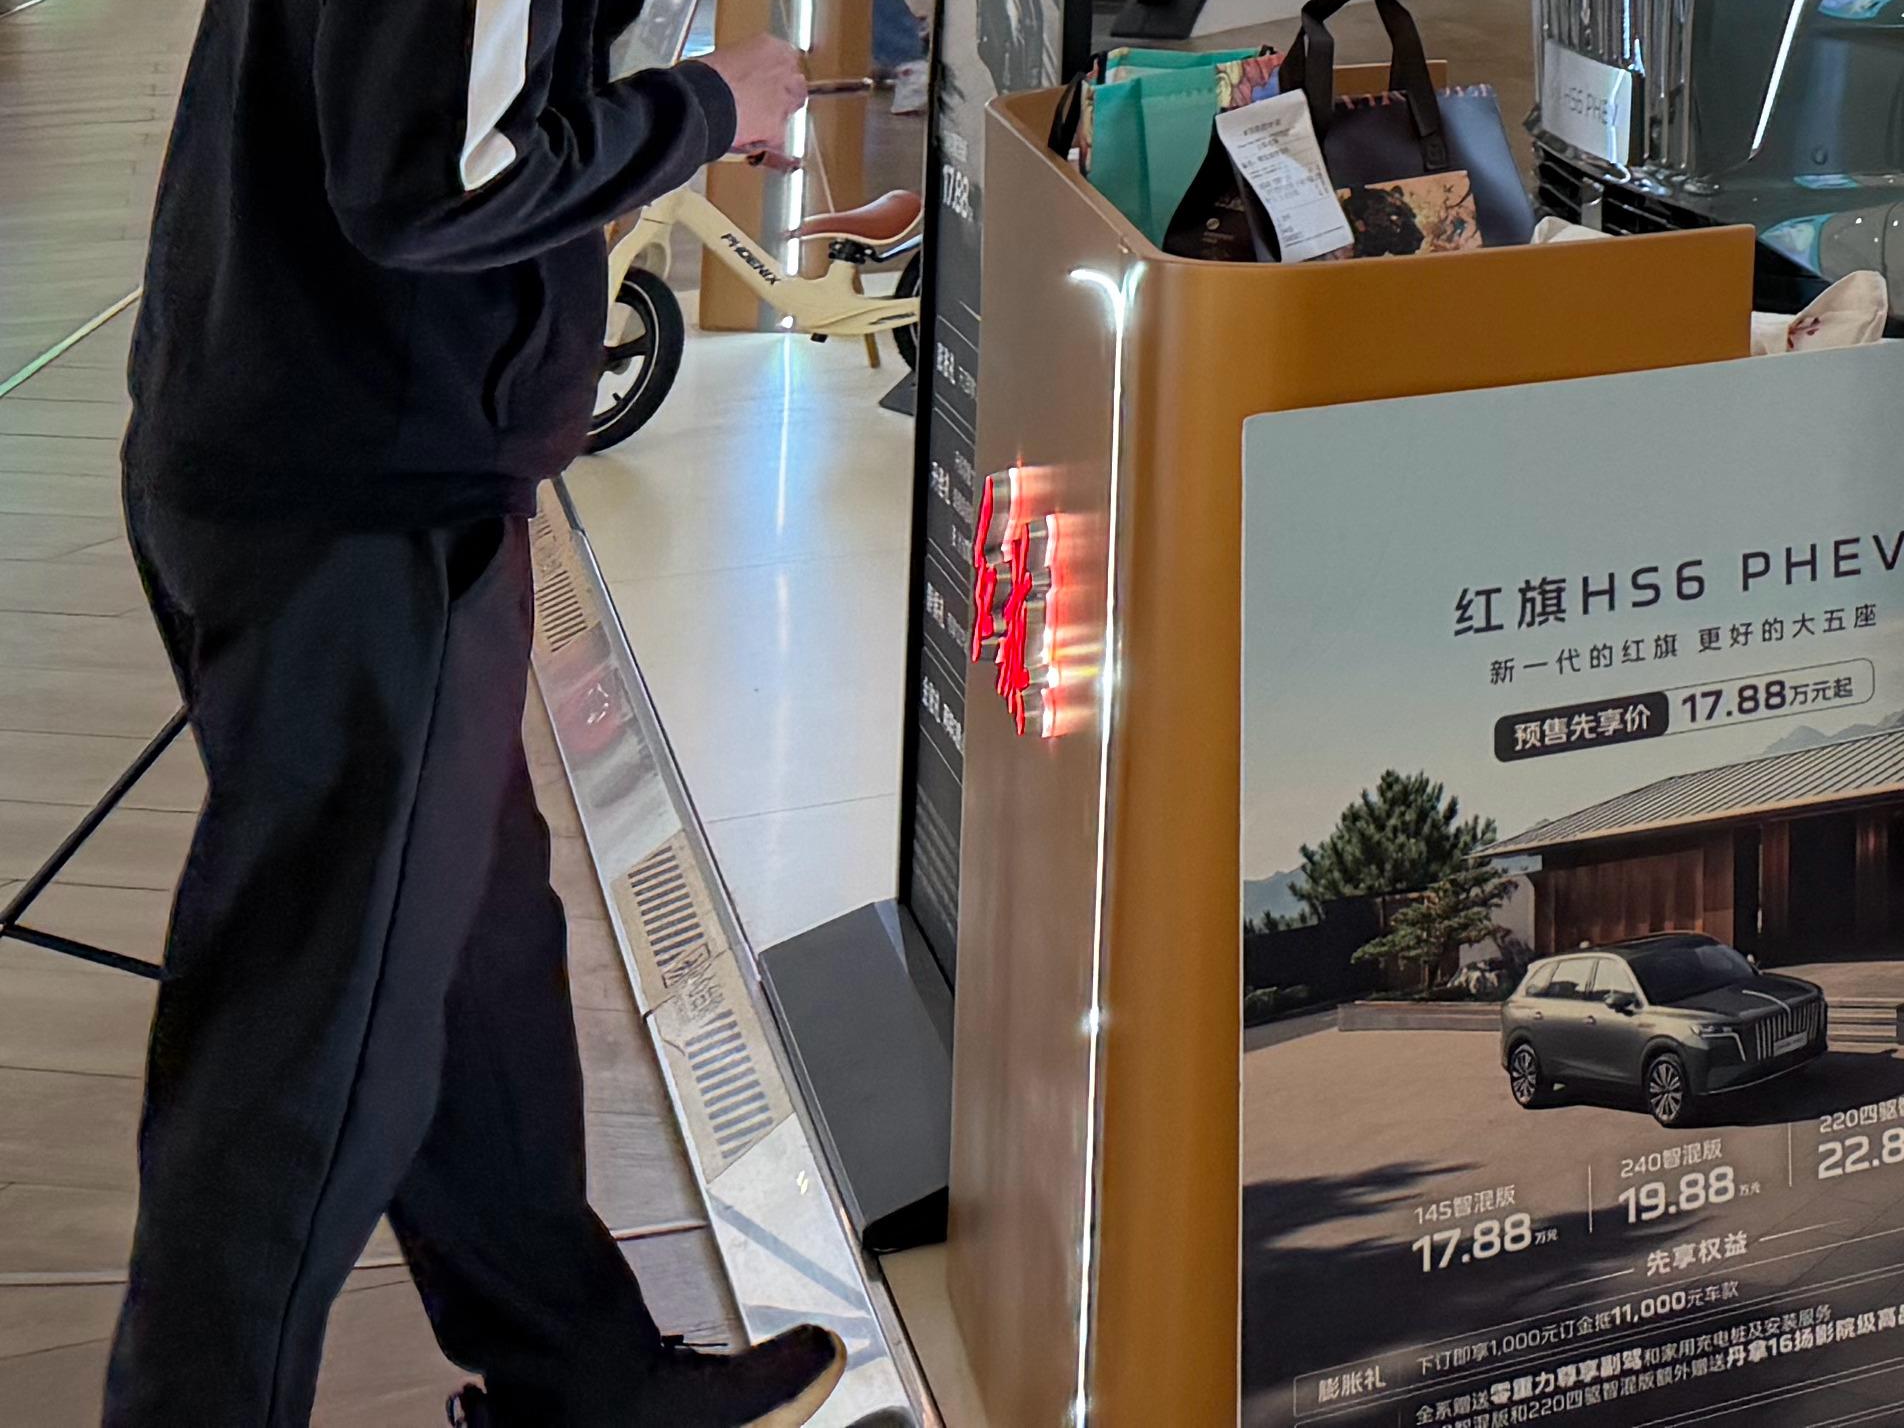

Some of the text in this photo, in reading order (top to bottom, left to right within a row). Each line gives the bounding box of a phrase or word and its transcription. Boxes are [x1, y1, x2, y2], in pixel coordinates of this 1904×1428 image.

[720, 231, 782, 288] PHOENIX
[1453, 557, 1709, 638] 红旗HS6
[1489, 601, 1880, 686] 新一代的红旗 更好的大五座
[1513, 674, 1853, 752] 预售先享价 17.88万元起
[1620, 1138, 1723, 1178] 240智混版
[1413, 1184, 1516, 1225] 145智混版
[1646, 1231, 1748, 1277] 先享权益
